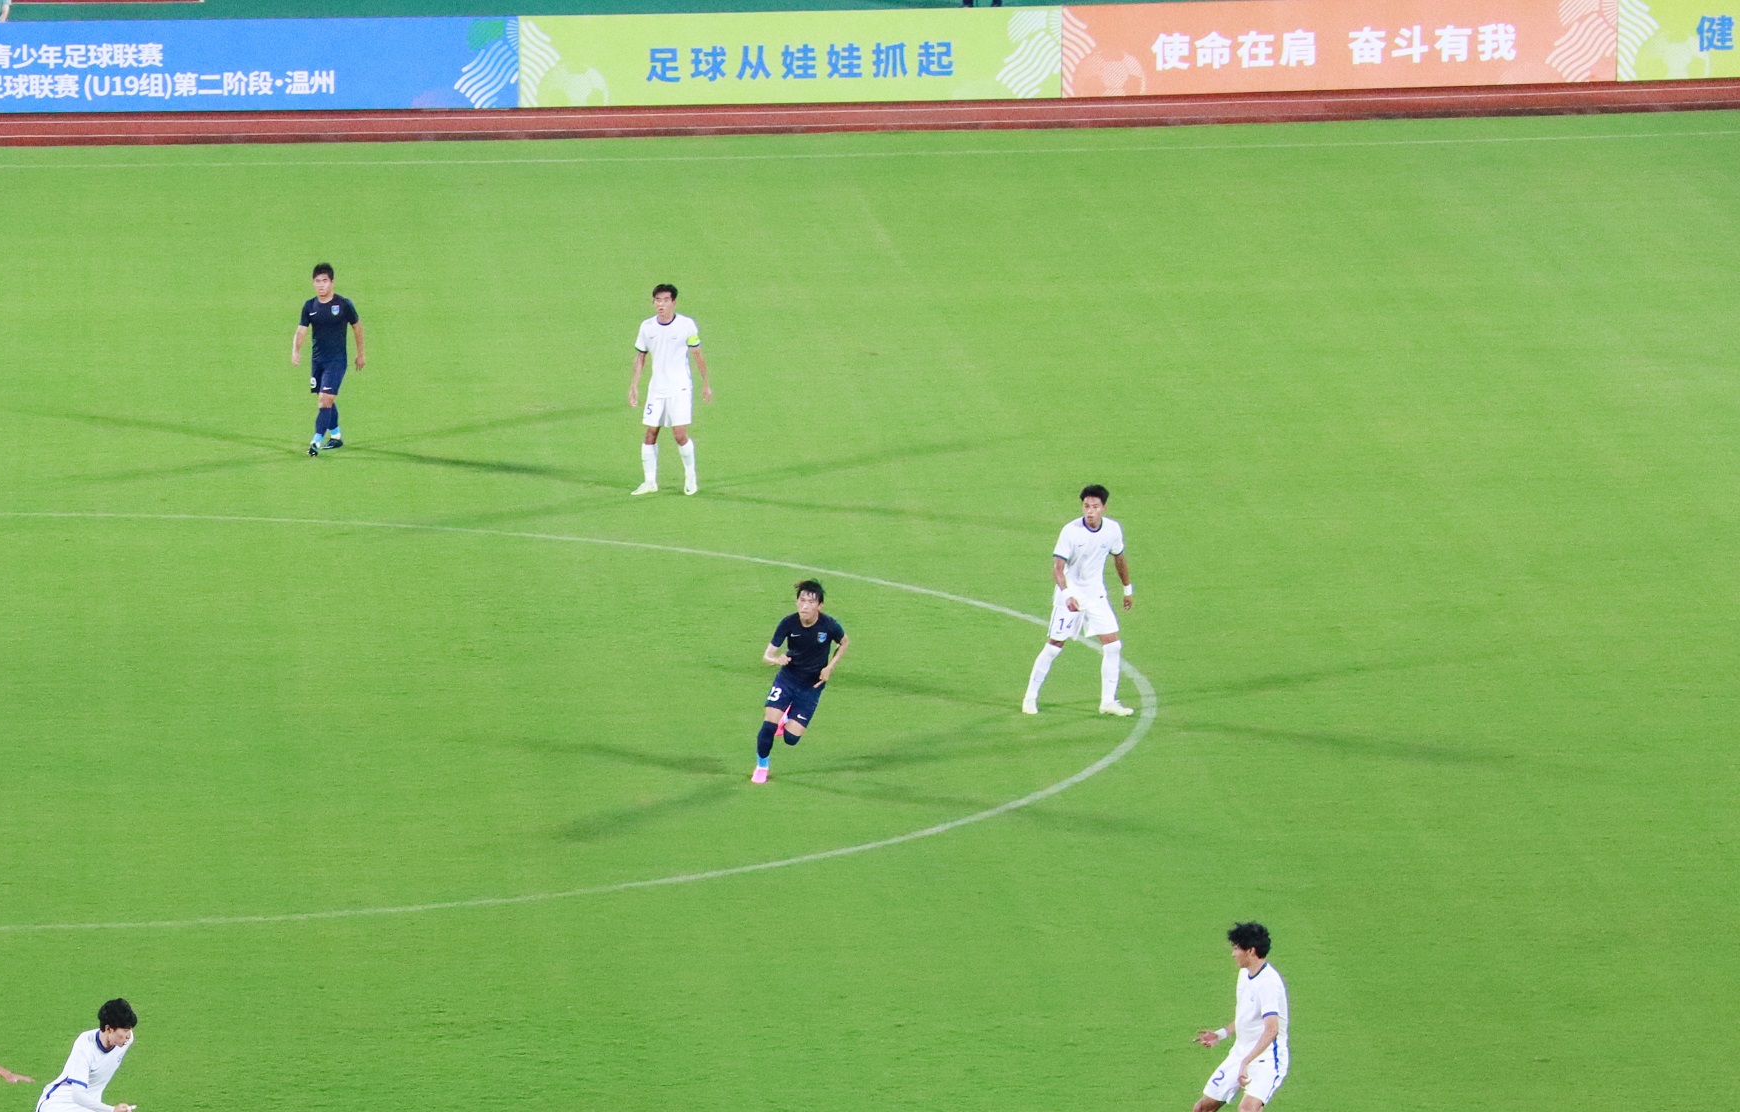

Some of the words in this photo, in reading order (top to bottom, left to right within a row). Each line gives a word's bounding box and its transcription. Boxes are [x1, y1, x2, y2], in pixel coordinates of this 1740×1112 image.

[1151, 29, 1318, 71] 使命在肩
[1347, 23, 1518, 65] 奋斗有我
[1696, 15, 1735, 52] 健
[646, 41, 955, 83] 足球从娃娃抓起
[1212, 1070, 1225, 1087] 2
